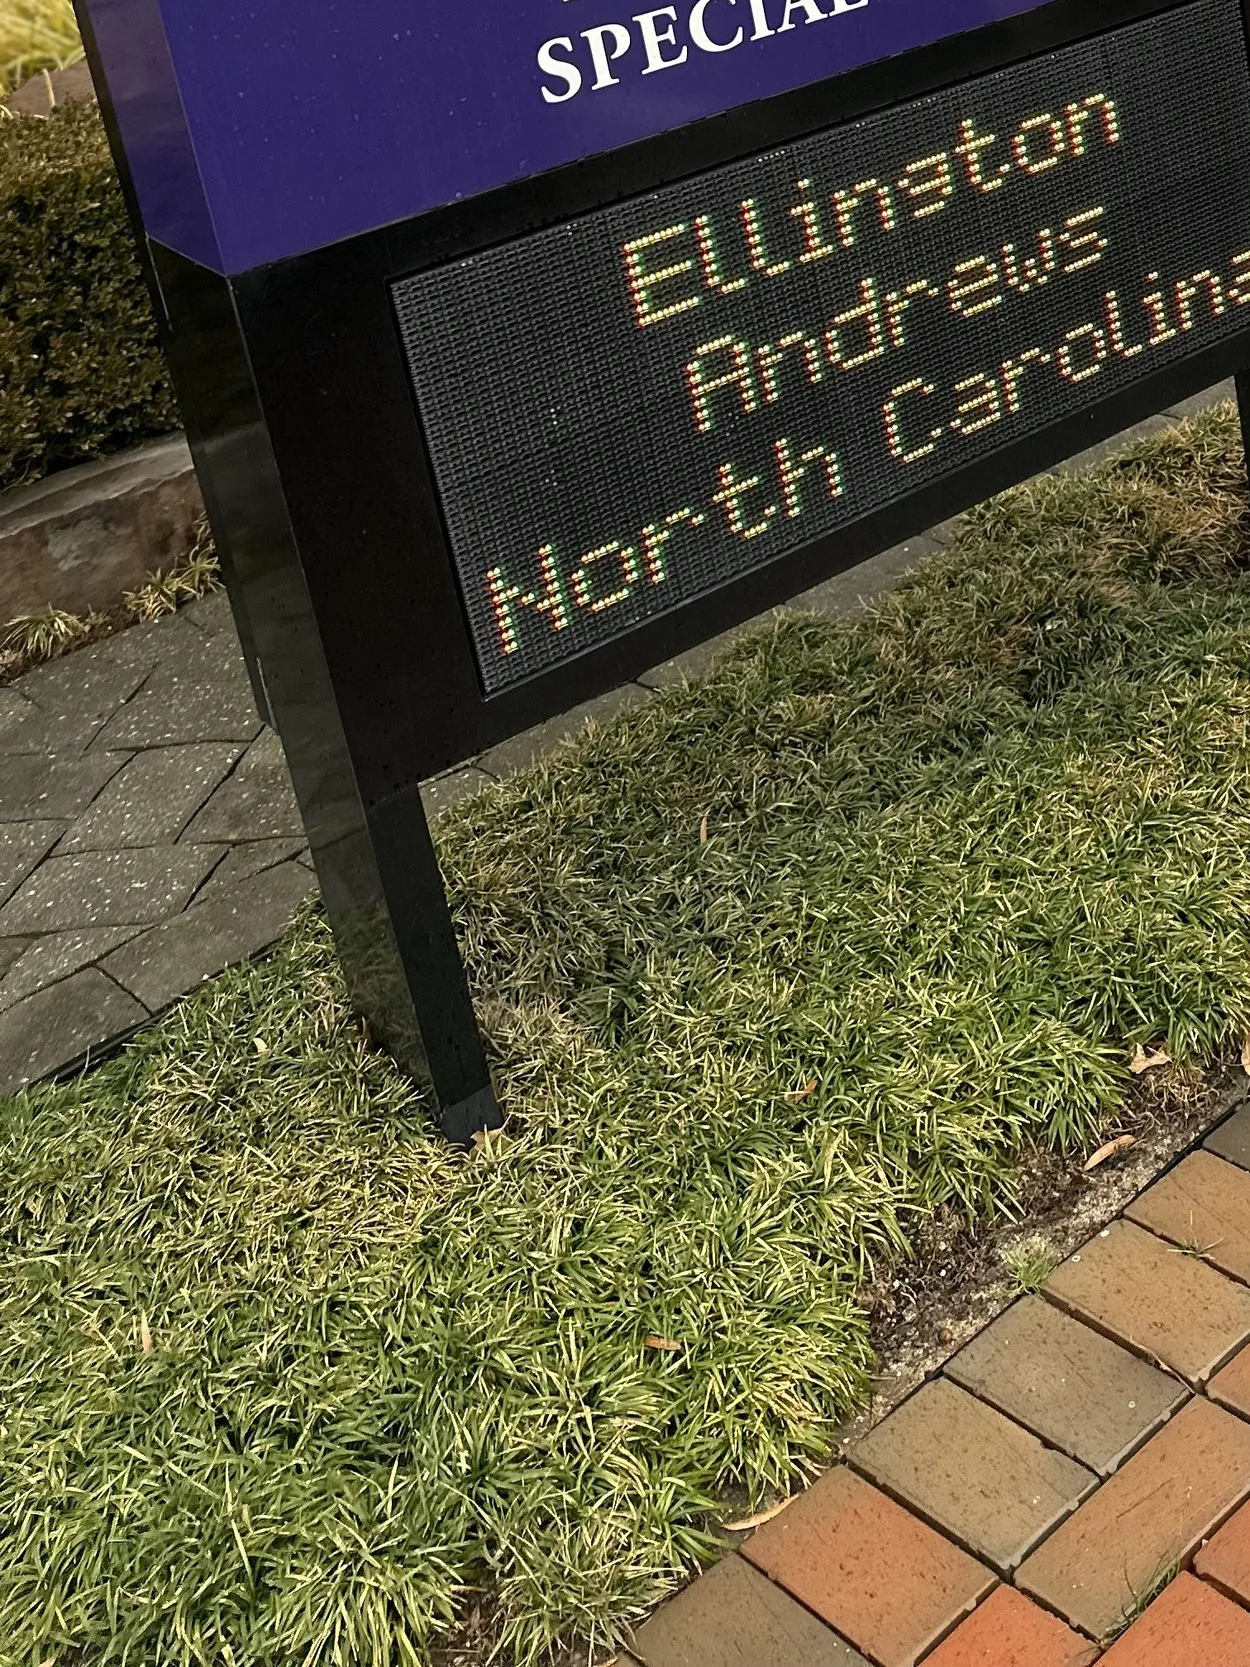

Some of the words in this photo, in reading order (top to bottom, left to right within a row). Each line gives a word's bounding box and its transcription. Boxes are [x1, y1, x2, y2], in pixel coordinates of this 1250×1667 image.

[623, 93, 1119, 327] Ellington
[686, 206, 1108, 432] Andrews
[486, 438, 843, 654] North
